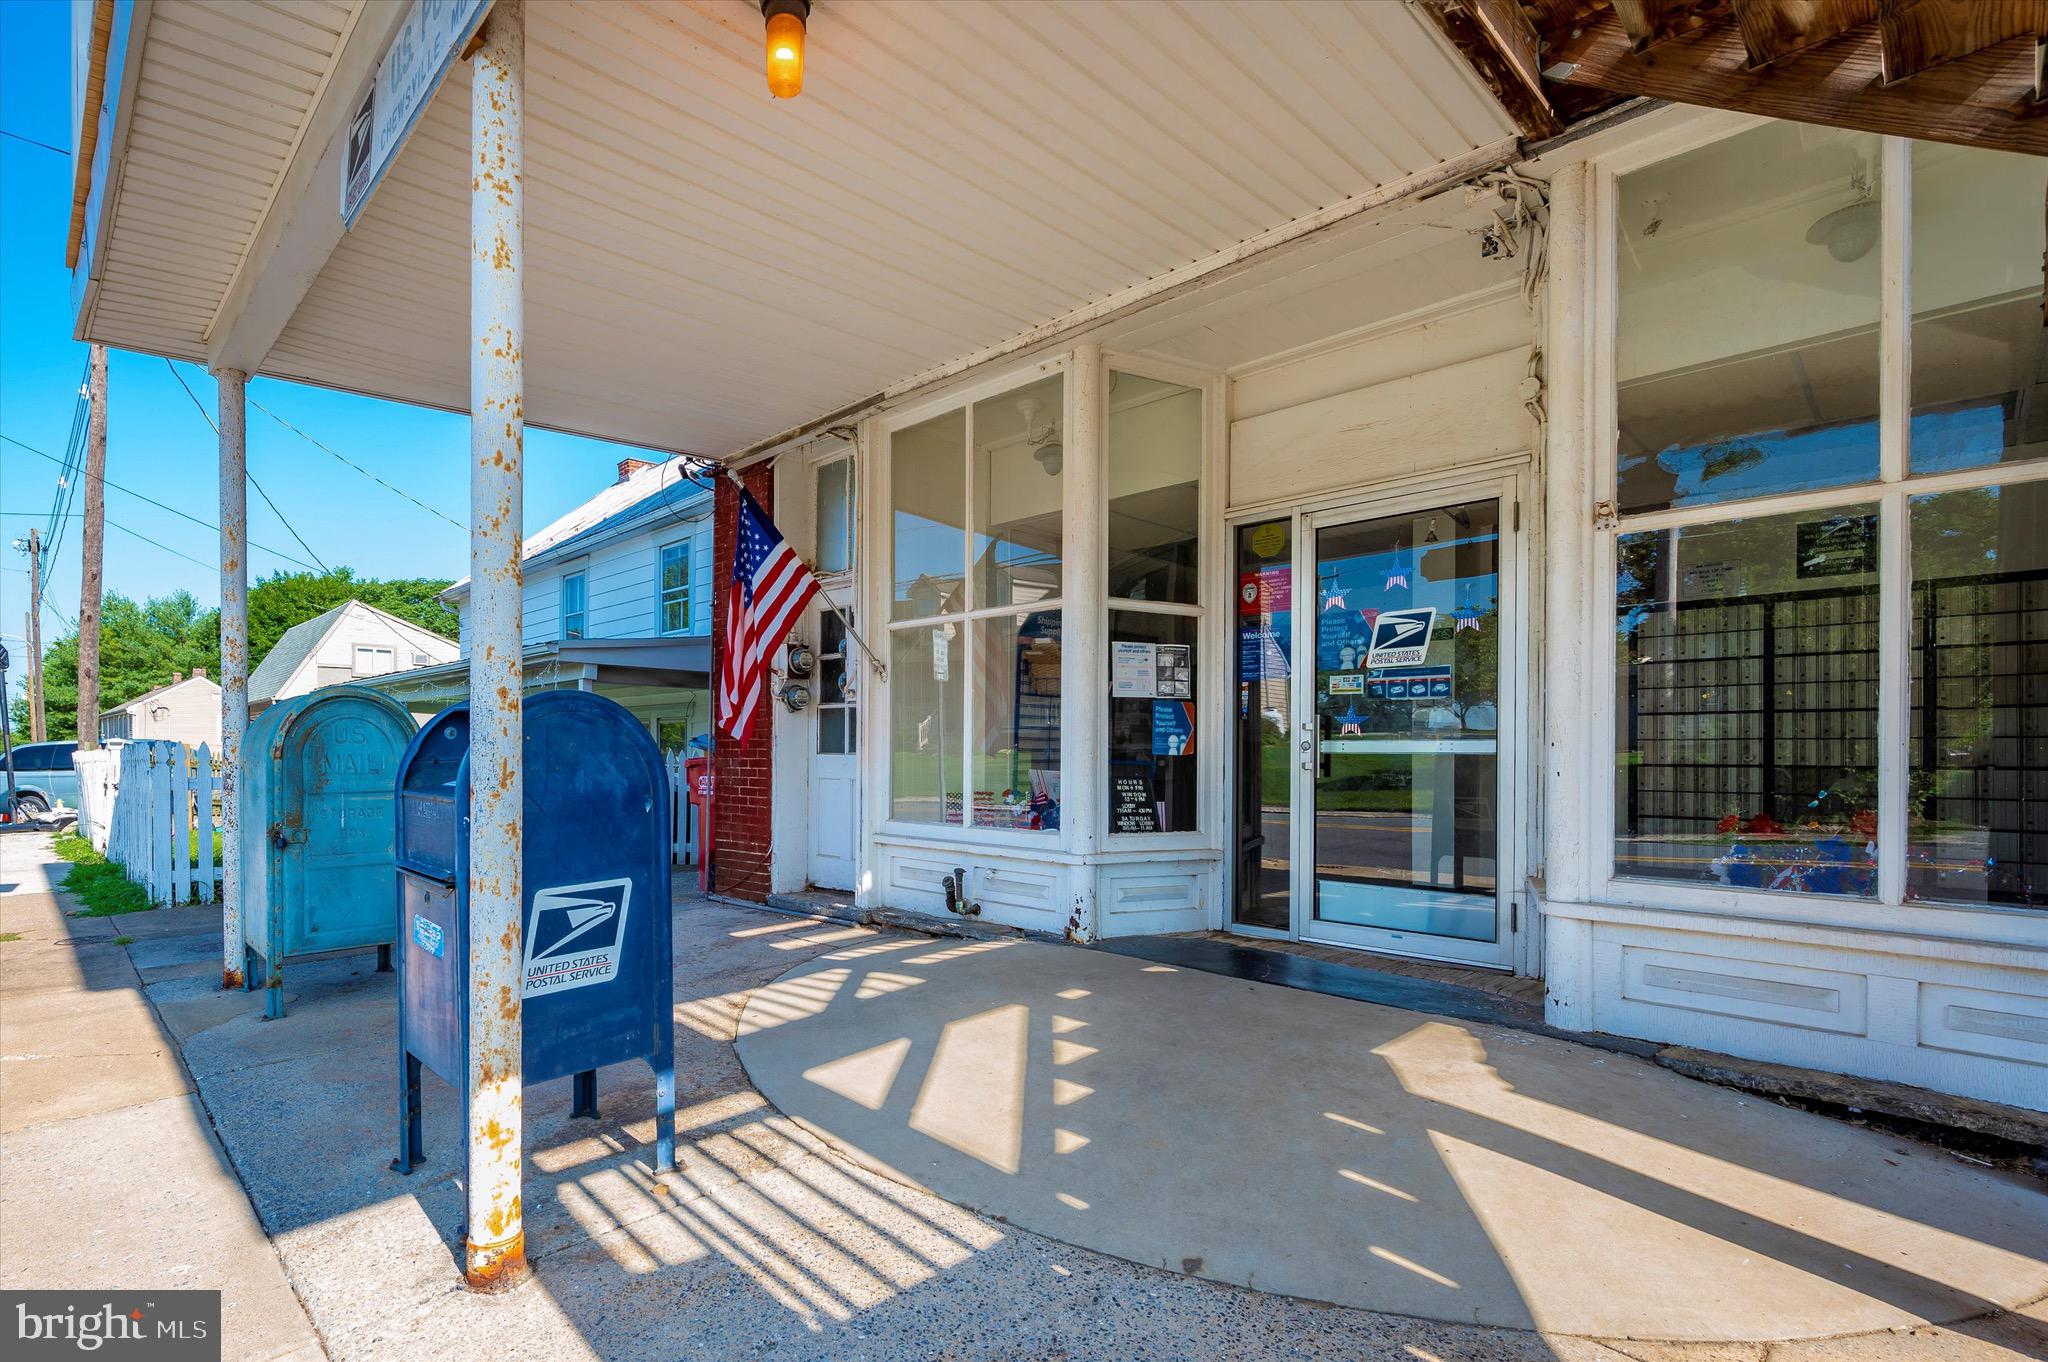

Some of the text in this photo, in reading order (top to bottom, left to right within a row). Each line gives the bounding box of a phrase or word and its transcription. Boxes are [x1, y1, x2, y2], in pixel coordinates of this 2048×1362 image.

[381, 31, 441, 151] CHEWSVILLE
[1242, 631, 1281, 640] Welcome
[1321, 631, 1351, 640] Yourself
[1370, 655, 1422, 665] POSTAL SERVICE
[1372, 649, 1421, 659] UNITED STATES
[1155, 705, 1173, 713] Please
[1155, 712, 1175, 720] Protect
[334, 724, 369, 745] U.S.
[319, 753, 384, 776] MAIL
[319, 806, 384, 820] STORAGE
[340, 826, 366, 840] BOX
[527, 953, 609, 978] UNITED STATES
[525, 964, 612, 991] POSTAL SERVICE
